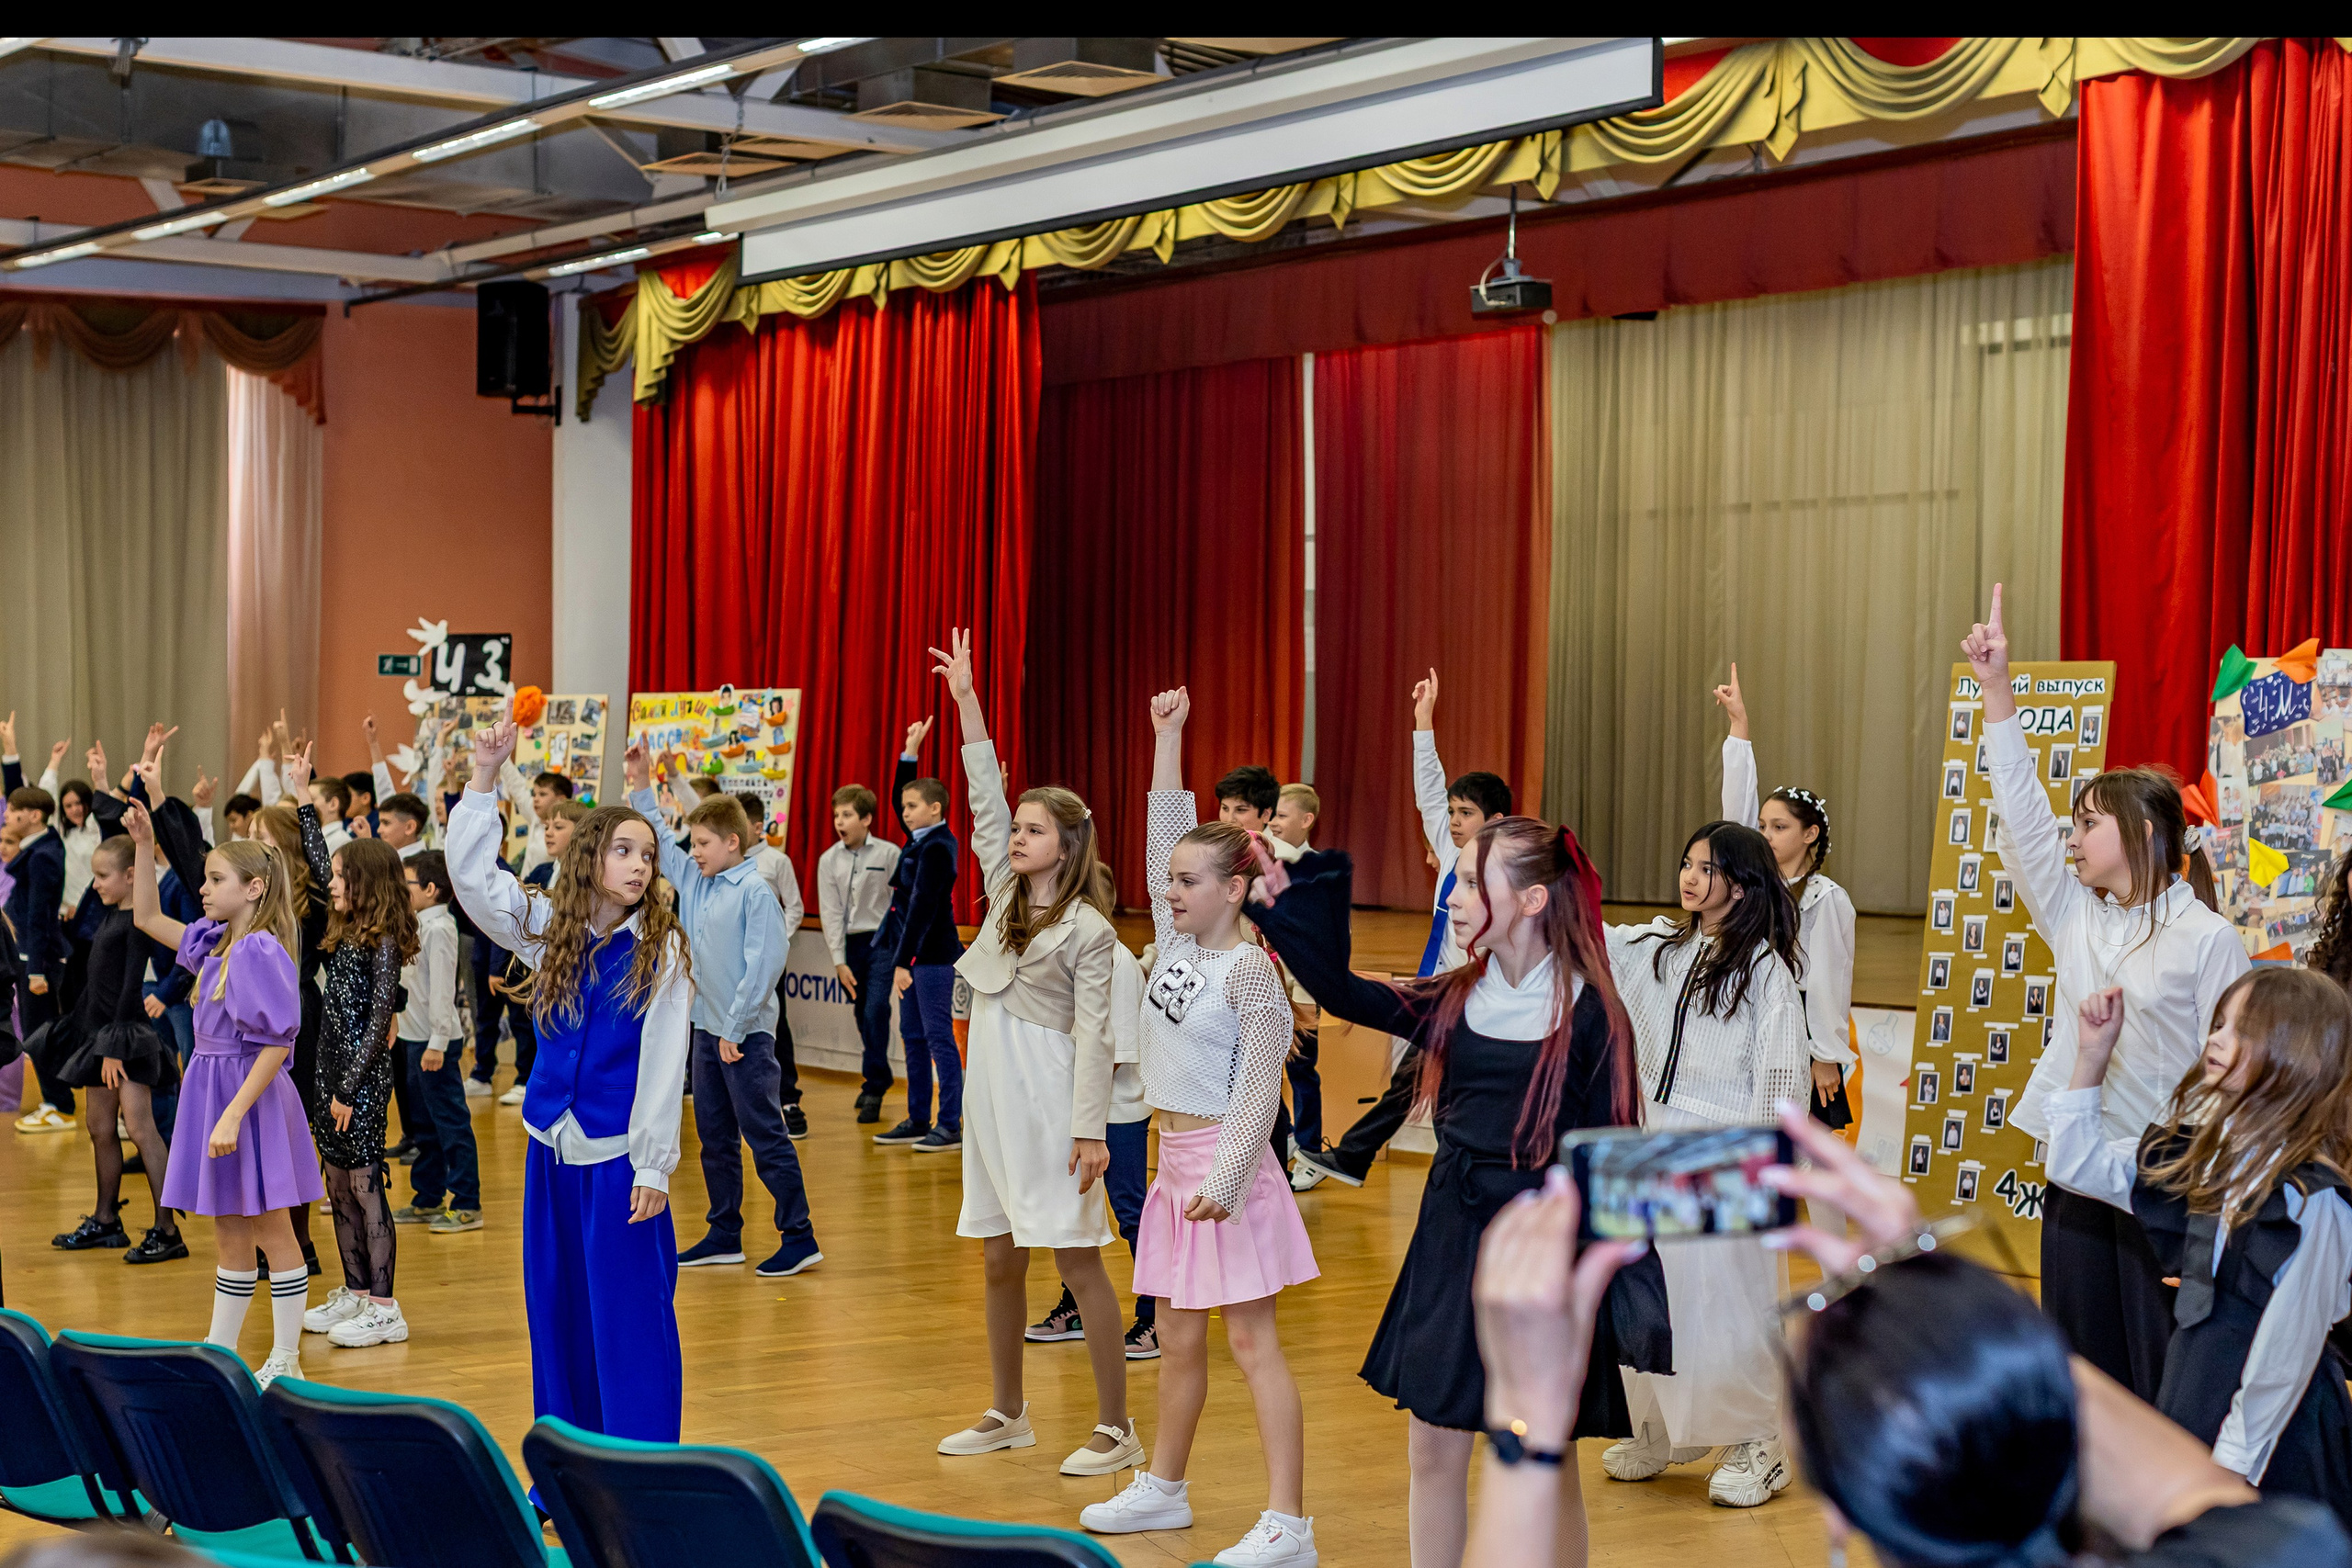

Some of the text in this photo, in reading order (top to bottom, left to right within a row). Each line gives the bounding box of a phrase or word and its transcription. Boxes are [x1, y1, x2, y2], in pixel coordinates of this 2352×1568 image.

[1958, 676, 2104, 698] Луий выпуск
[2018, 708, 2074, 734] ОДА
[1995, 1171, 2046, 1218] 4Ж
